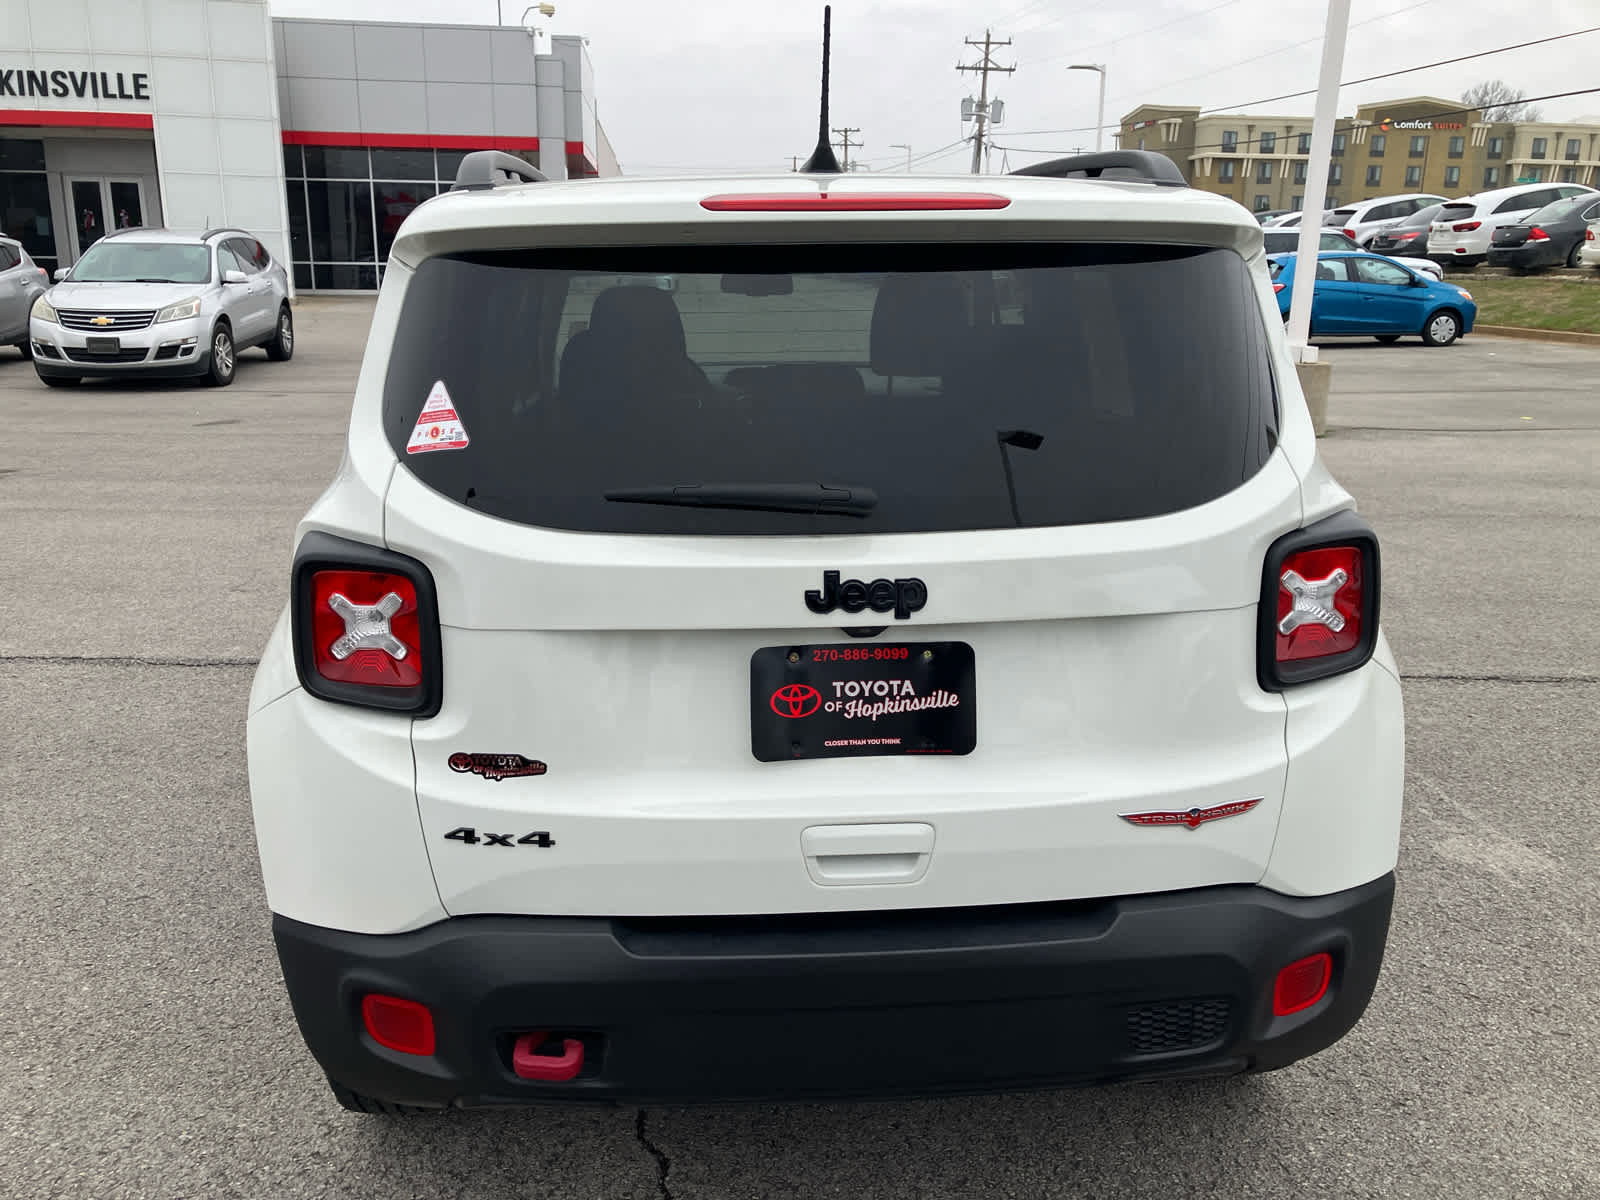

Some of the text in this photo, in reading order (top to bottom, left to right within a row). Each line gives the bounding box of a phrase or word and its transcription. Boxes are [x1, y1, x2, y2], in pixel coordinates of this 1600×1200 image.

[0, 69, 150, 100] KINSVILLE
[1394, 119, 1432, 129] Comfort
[804, 569, 928, 619] Jeep
[812, 647, 909, 662] 270-886-9099
[832, 680, 915, 697] TOYOTA
[824, 689, 960, 721] OF Hopkinsville
[444, 827, 556, 848] 4x4
